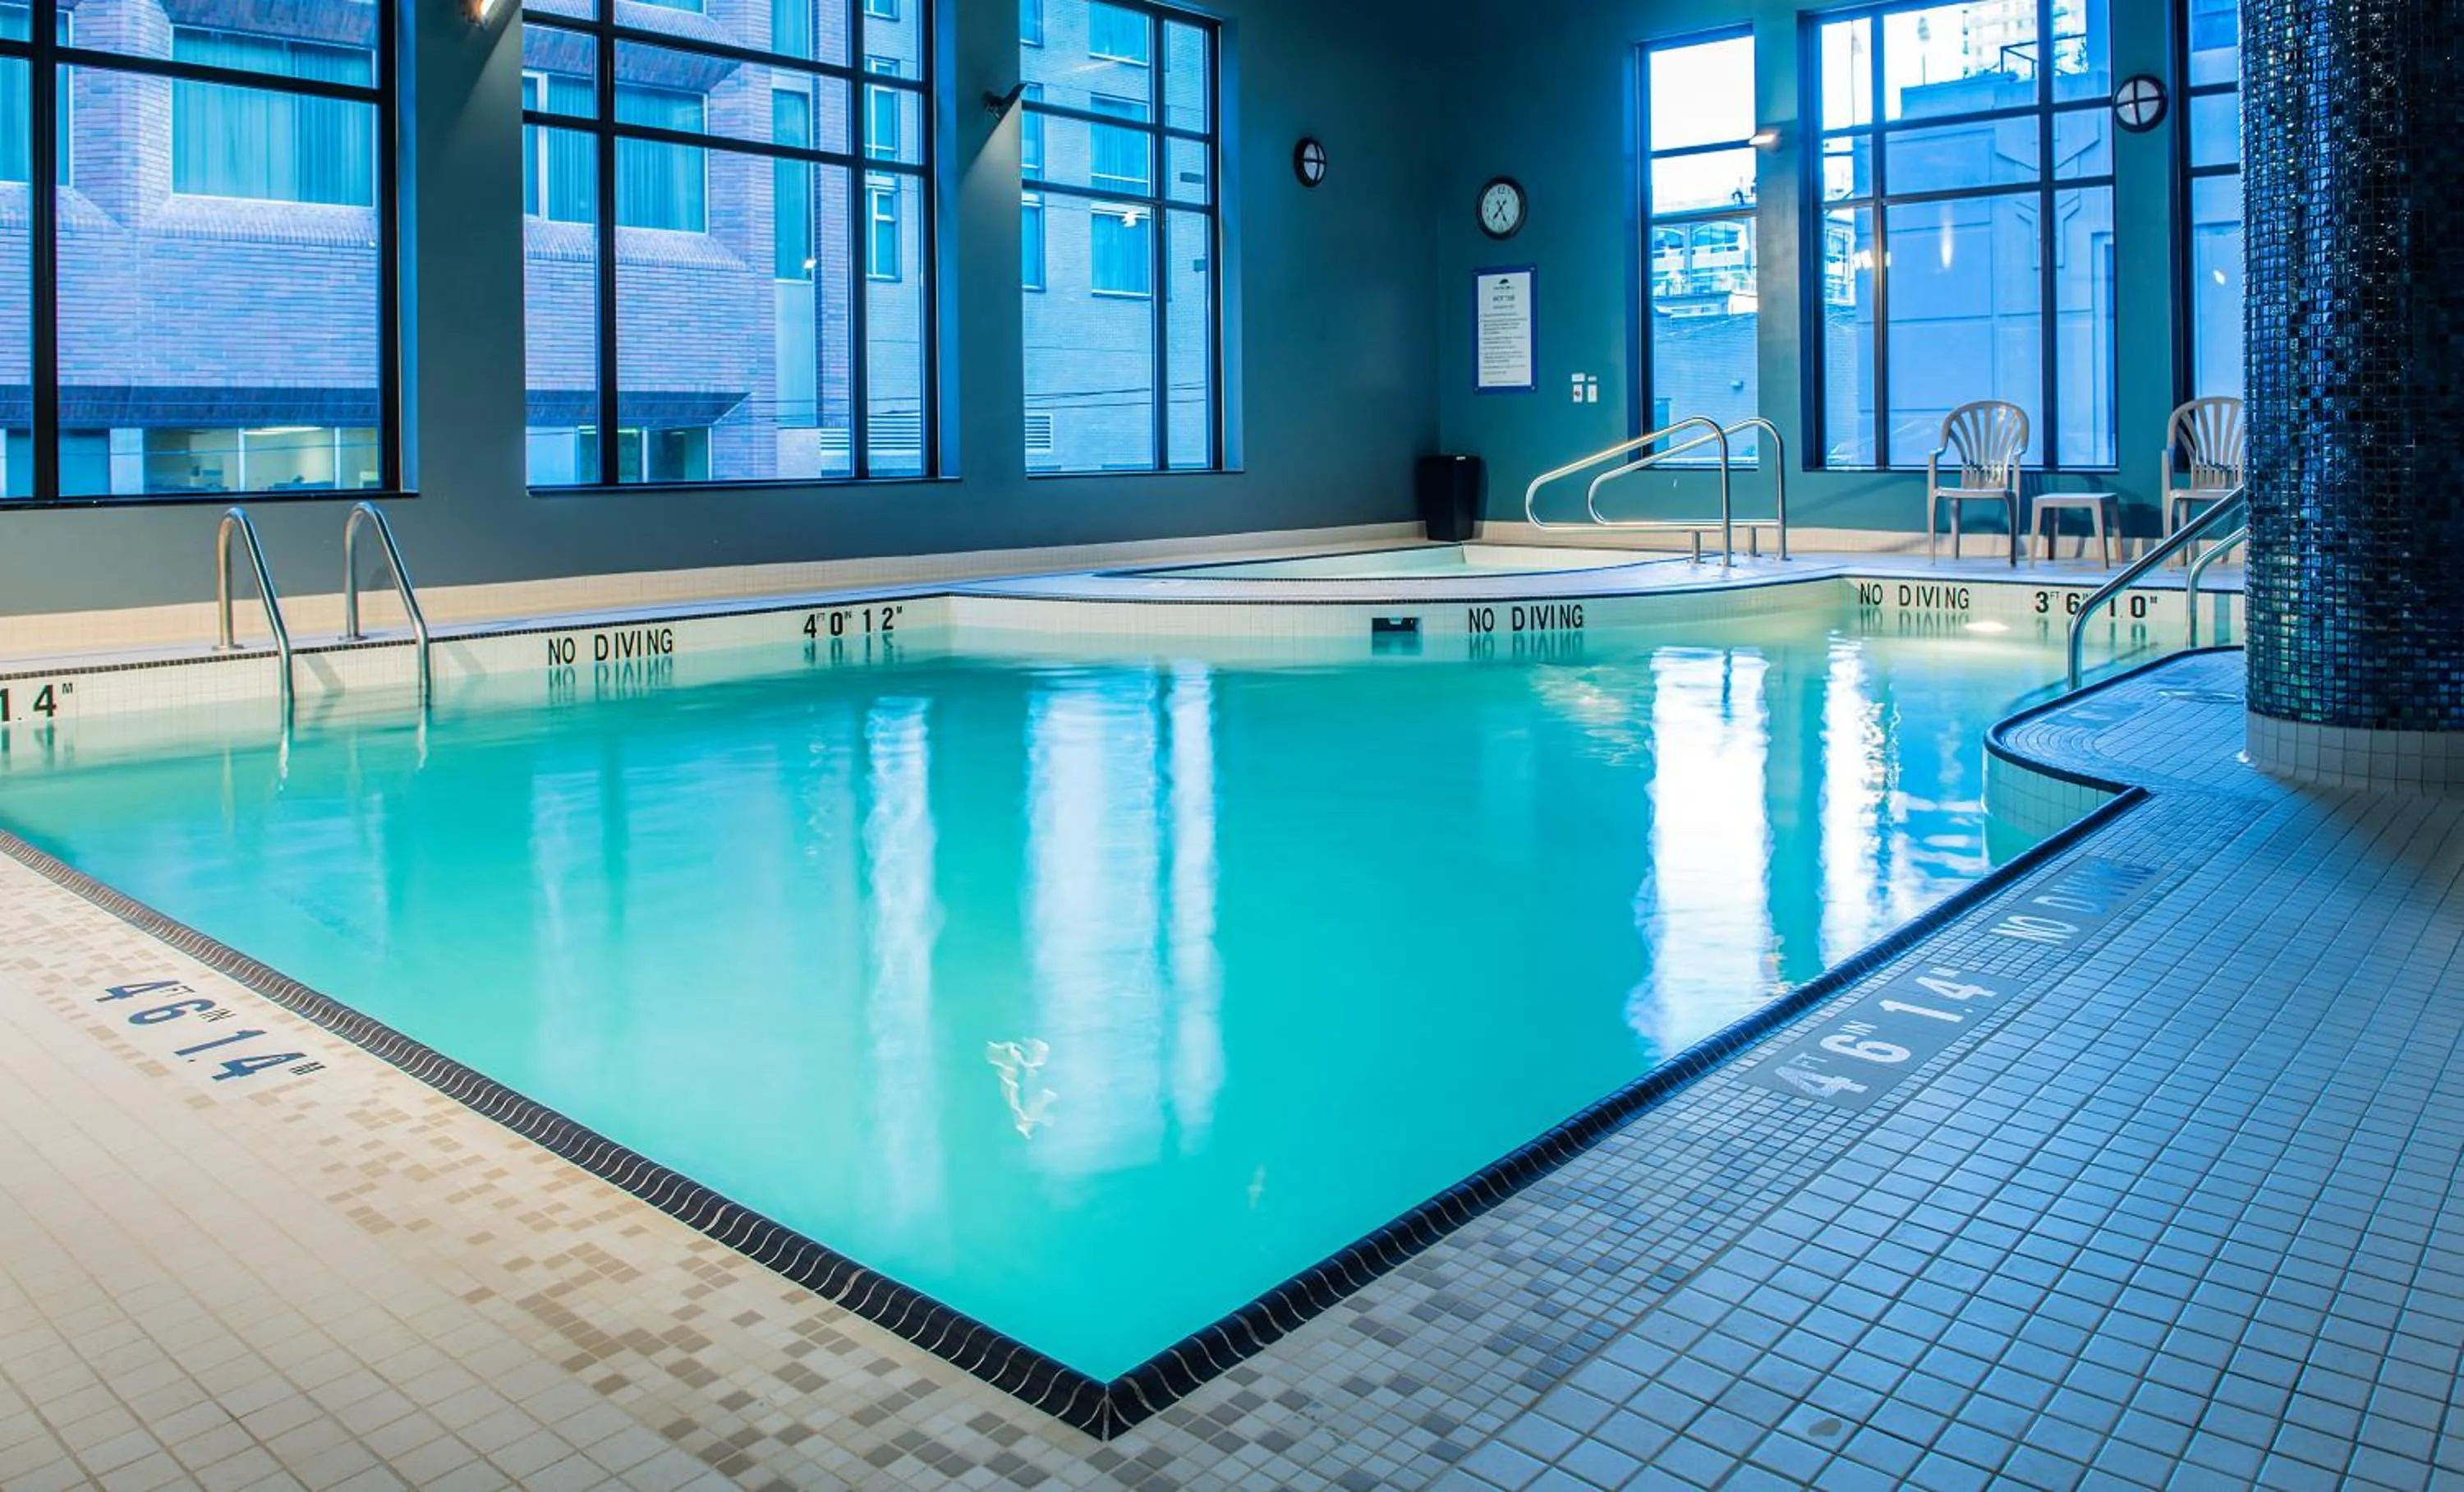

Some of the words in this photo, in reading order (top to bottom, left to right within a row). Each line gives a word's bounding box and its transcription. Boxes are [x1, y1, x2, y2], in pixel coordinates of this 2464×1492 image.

[1860, 583, 1883, 606] NO
[1899, 584, 1969, 610] DIVING
[1469, 607, 1495, 633] NO
[1512, 604, 1584, 632] DIVING
[548, 637, 575, 666] NO
[595, 629, 673, 661] DIVING
[1989, 914, 2080, 945] NO
